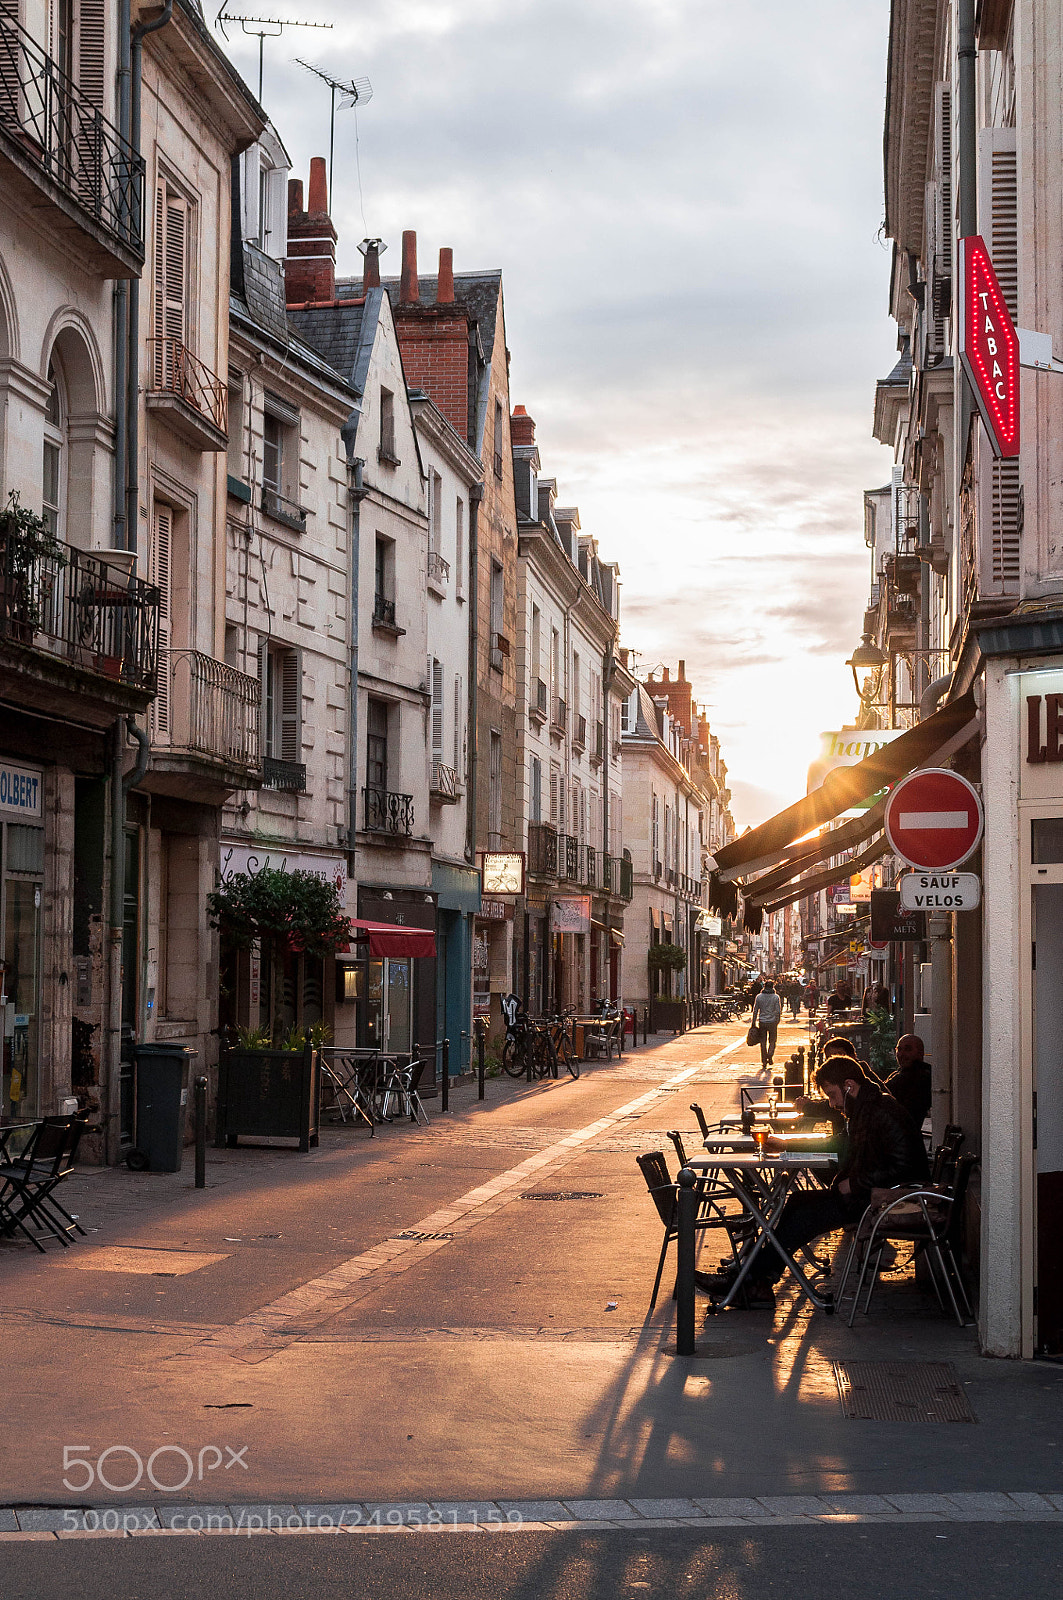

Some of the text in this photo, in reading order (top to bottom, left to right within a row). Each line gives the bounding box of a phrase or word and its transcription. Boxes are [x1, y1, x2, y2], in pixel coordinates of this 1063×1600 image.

[979, 293, 1006, 400] TABAC
[0, 771, 38, 809] OLBERT
[920, 877, 960, 888] SAUF
[915, 896, 964, 906] VELOS
[893, 925, 917, 933] METS
